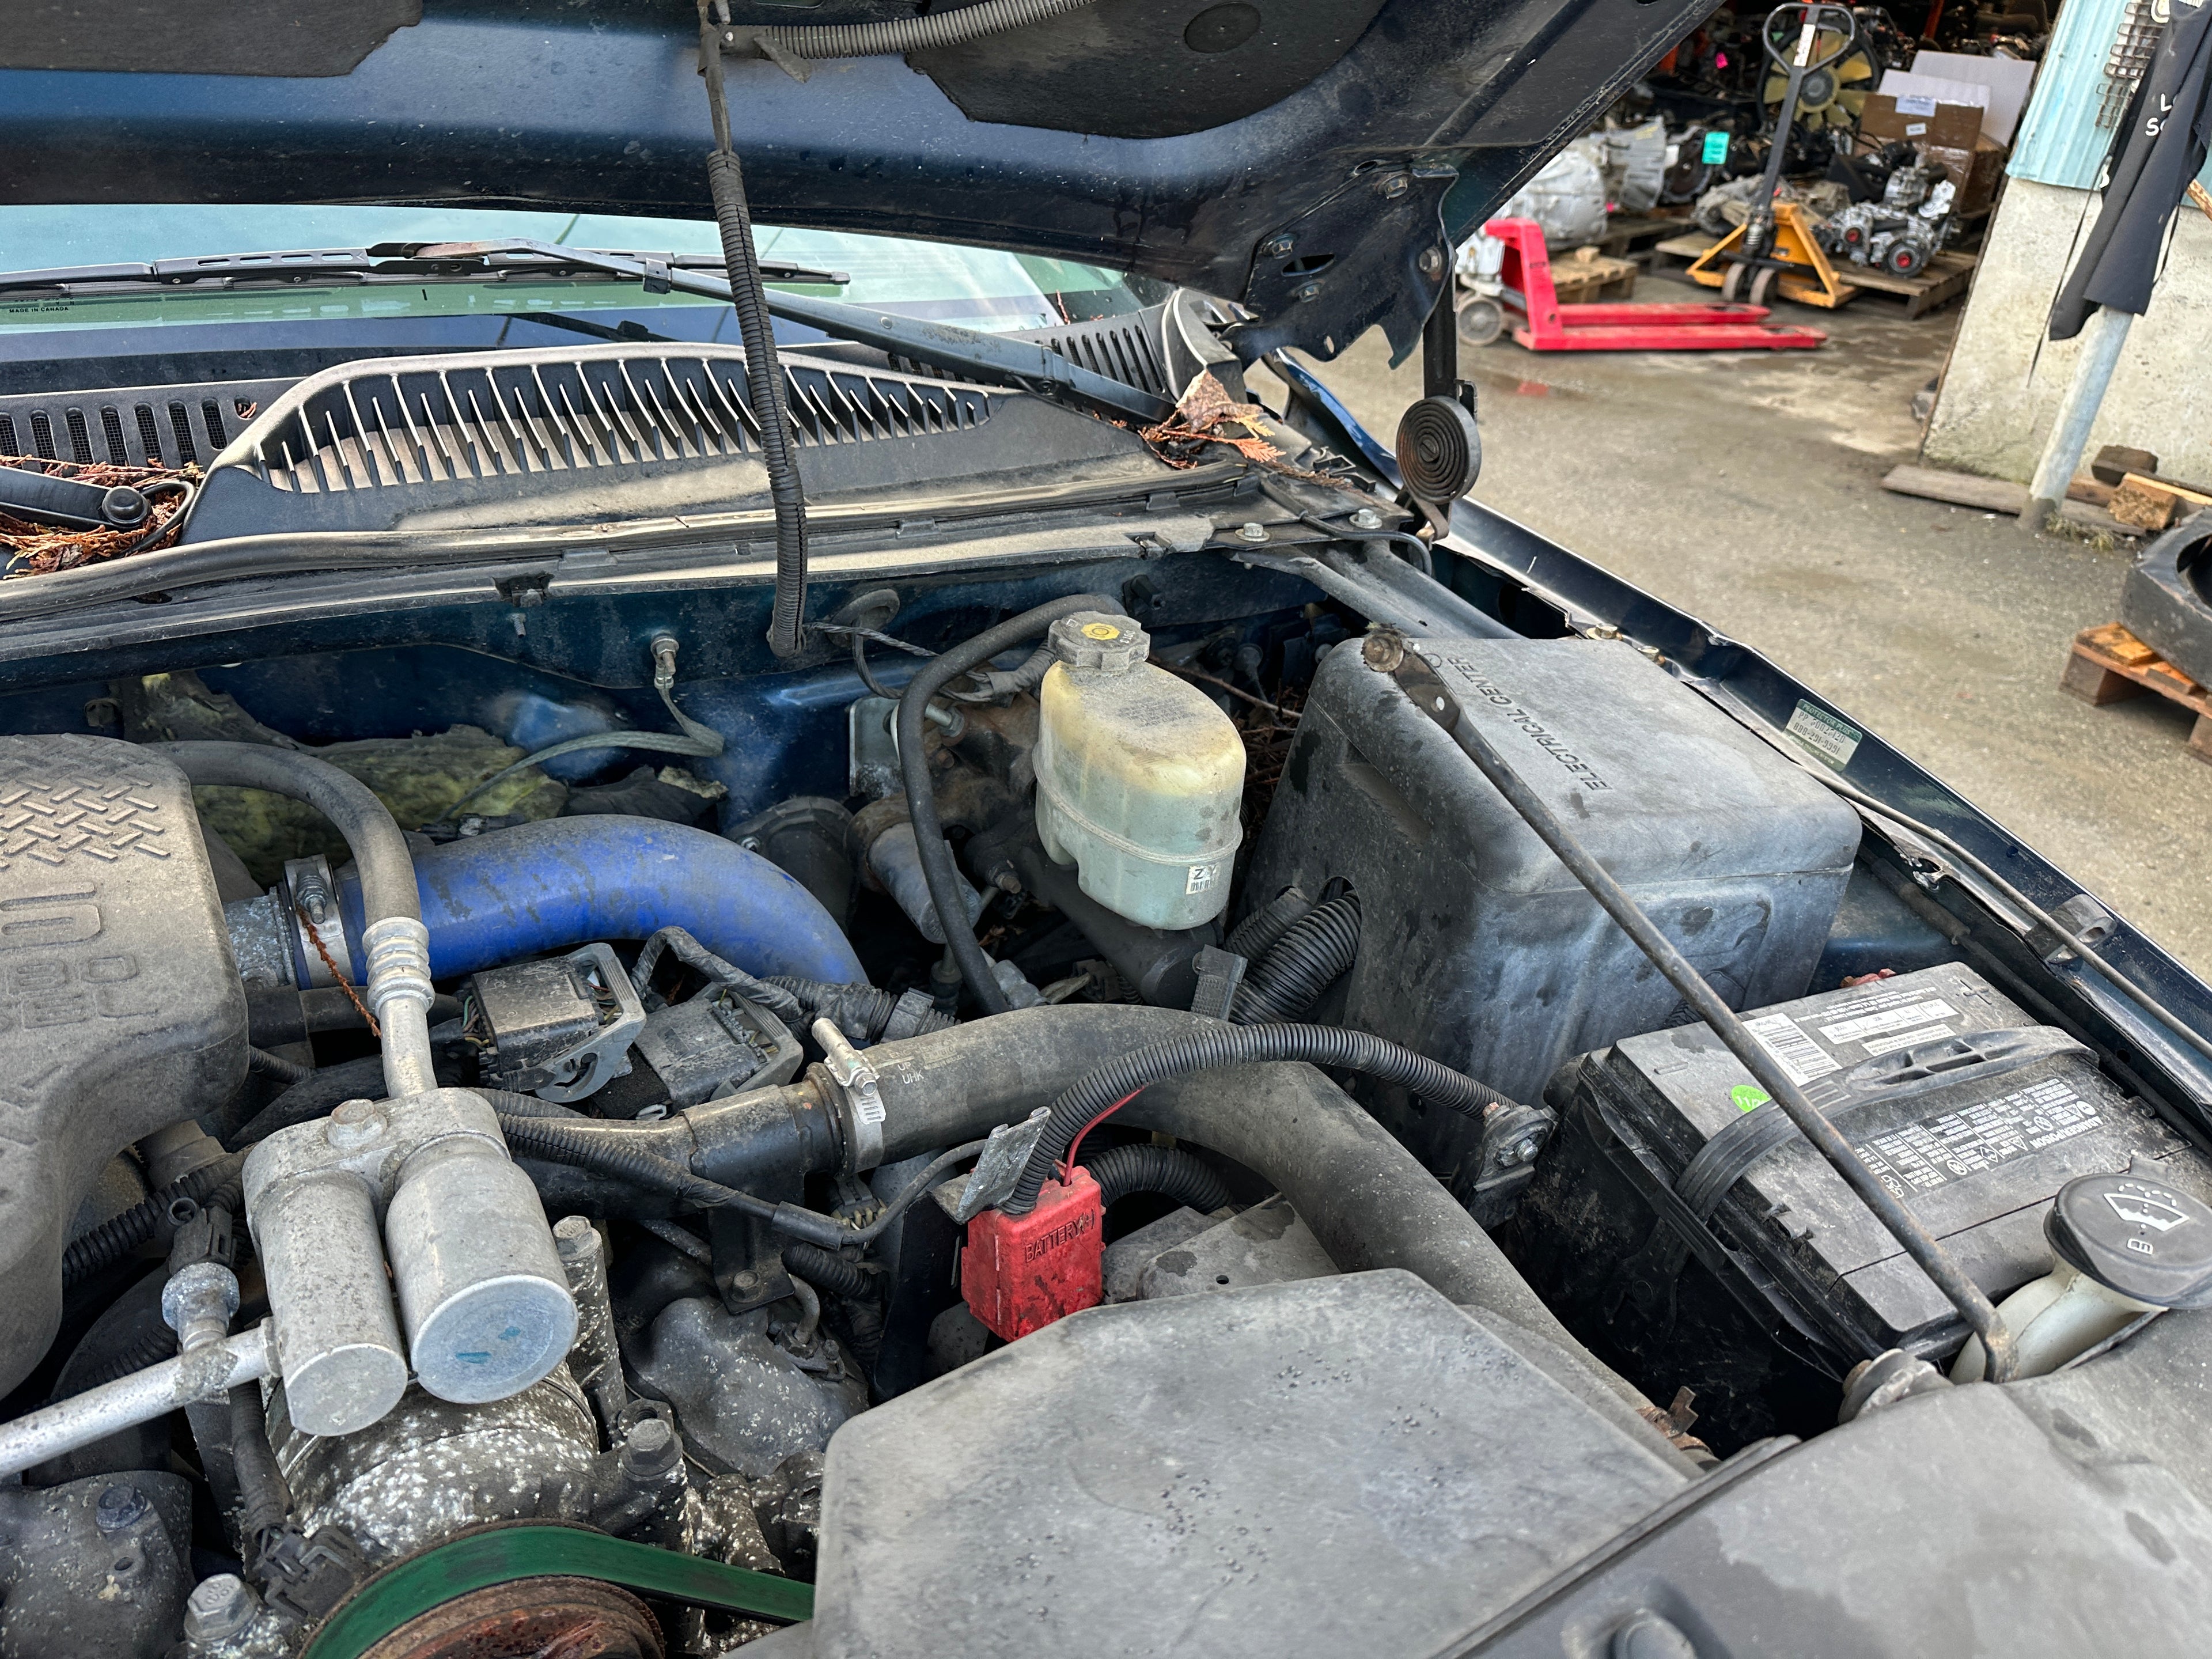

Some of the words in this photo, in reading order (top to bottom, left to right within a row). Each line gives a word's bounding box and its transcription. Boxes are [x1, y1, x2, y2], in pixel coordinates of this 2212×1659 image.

[1447, 657, 1512, 705] CENTER
[1798, 711, 1809, 722] PP
[1802, 703, 1835, 726] PROTECTOR
[1835, 721, 1851, 735] PLUS
[1506, 709, 1612, 791] ELECTRICAL
[889, 1049, 912, 1059] ENG
[897, 1062, 911, 1071] UP
[902, 1069, 924, 1084] UHK
